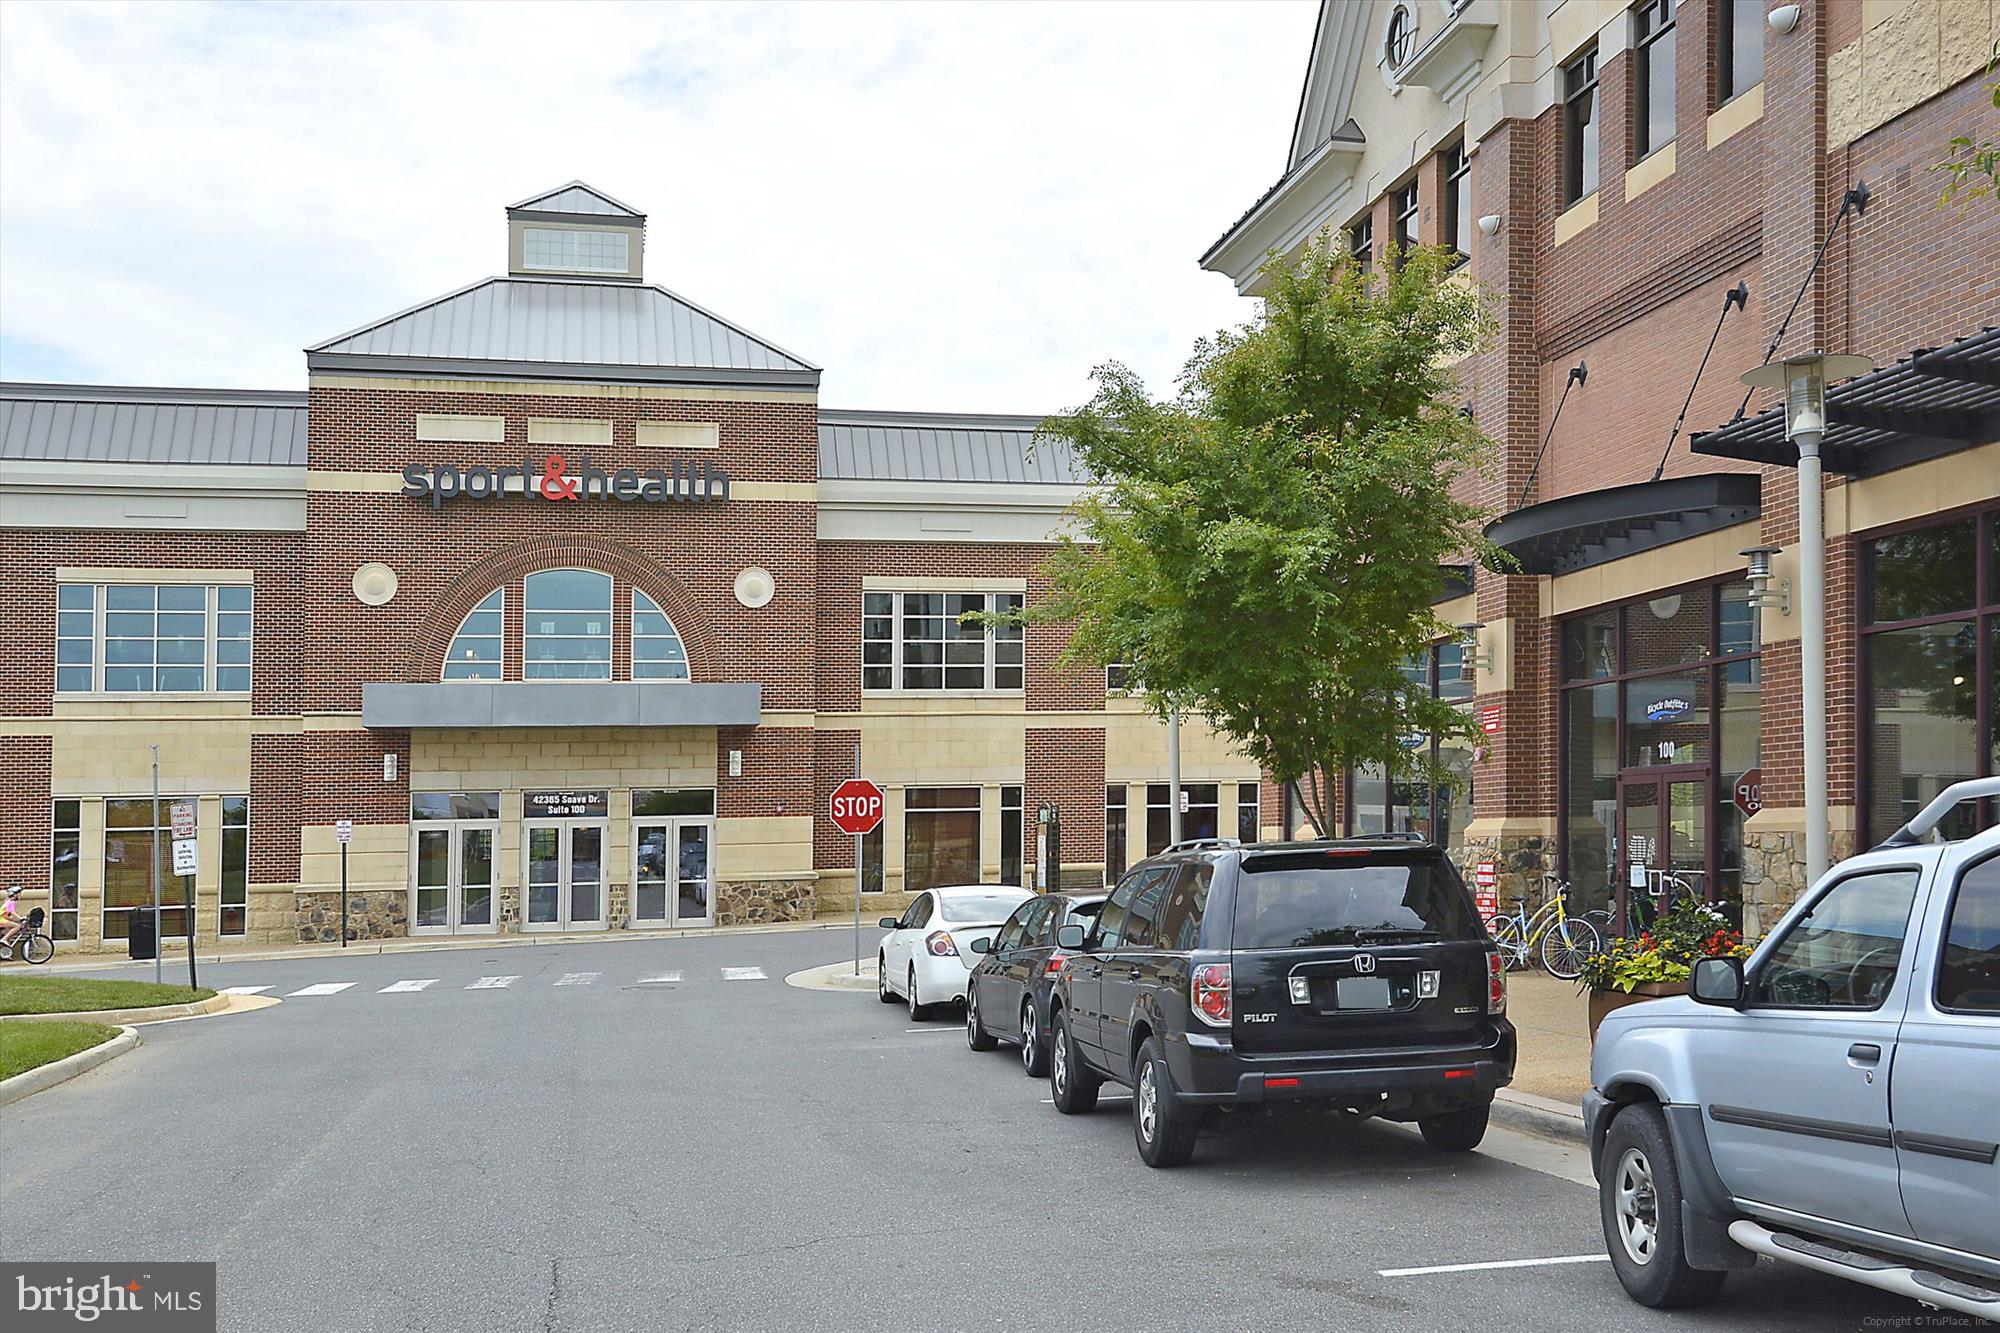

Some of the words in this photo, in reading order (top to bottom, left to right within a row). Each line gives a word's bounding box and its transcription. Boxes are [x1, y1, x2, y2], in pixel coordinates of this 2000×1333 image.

[401, 454, 729, 511] sport&health
[1658, 741, 1675, 758] 100
[588, 794, 601, 803] Dr.
[547, 805, 569, 814] Suite
[571, 805, 585, 814] 100
[834, 796, 880, 817] STOP
[1243, 1013, 1278, 1023] PILOT
